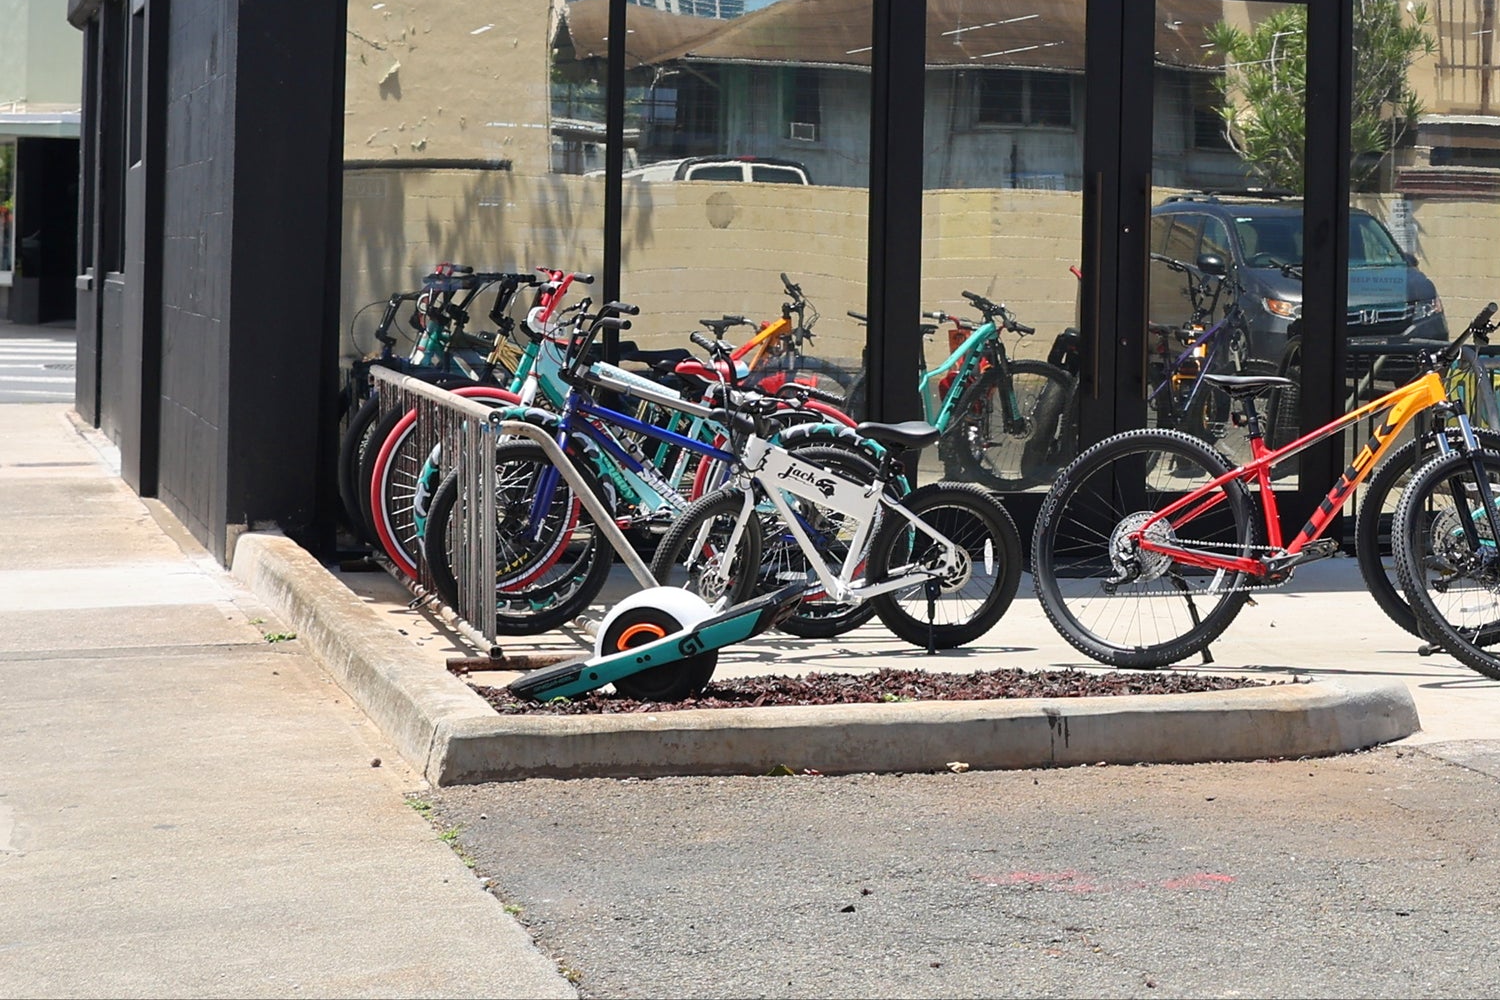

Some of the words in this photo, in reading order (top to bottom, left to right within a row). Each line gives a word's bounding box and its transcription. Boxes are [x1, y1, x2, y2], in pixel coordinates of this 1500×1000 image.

[777, 462, 816, 484] jack
[1300, 402, 1398, 538] TREK
[677, 631, 705, 657] GT
